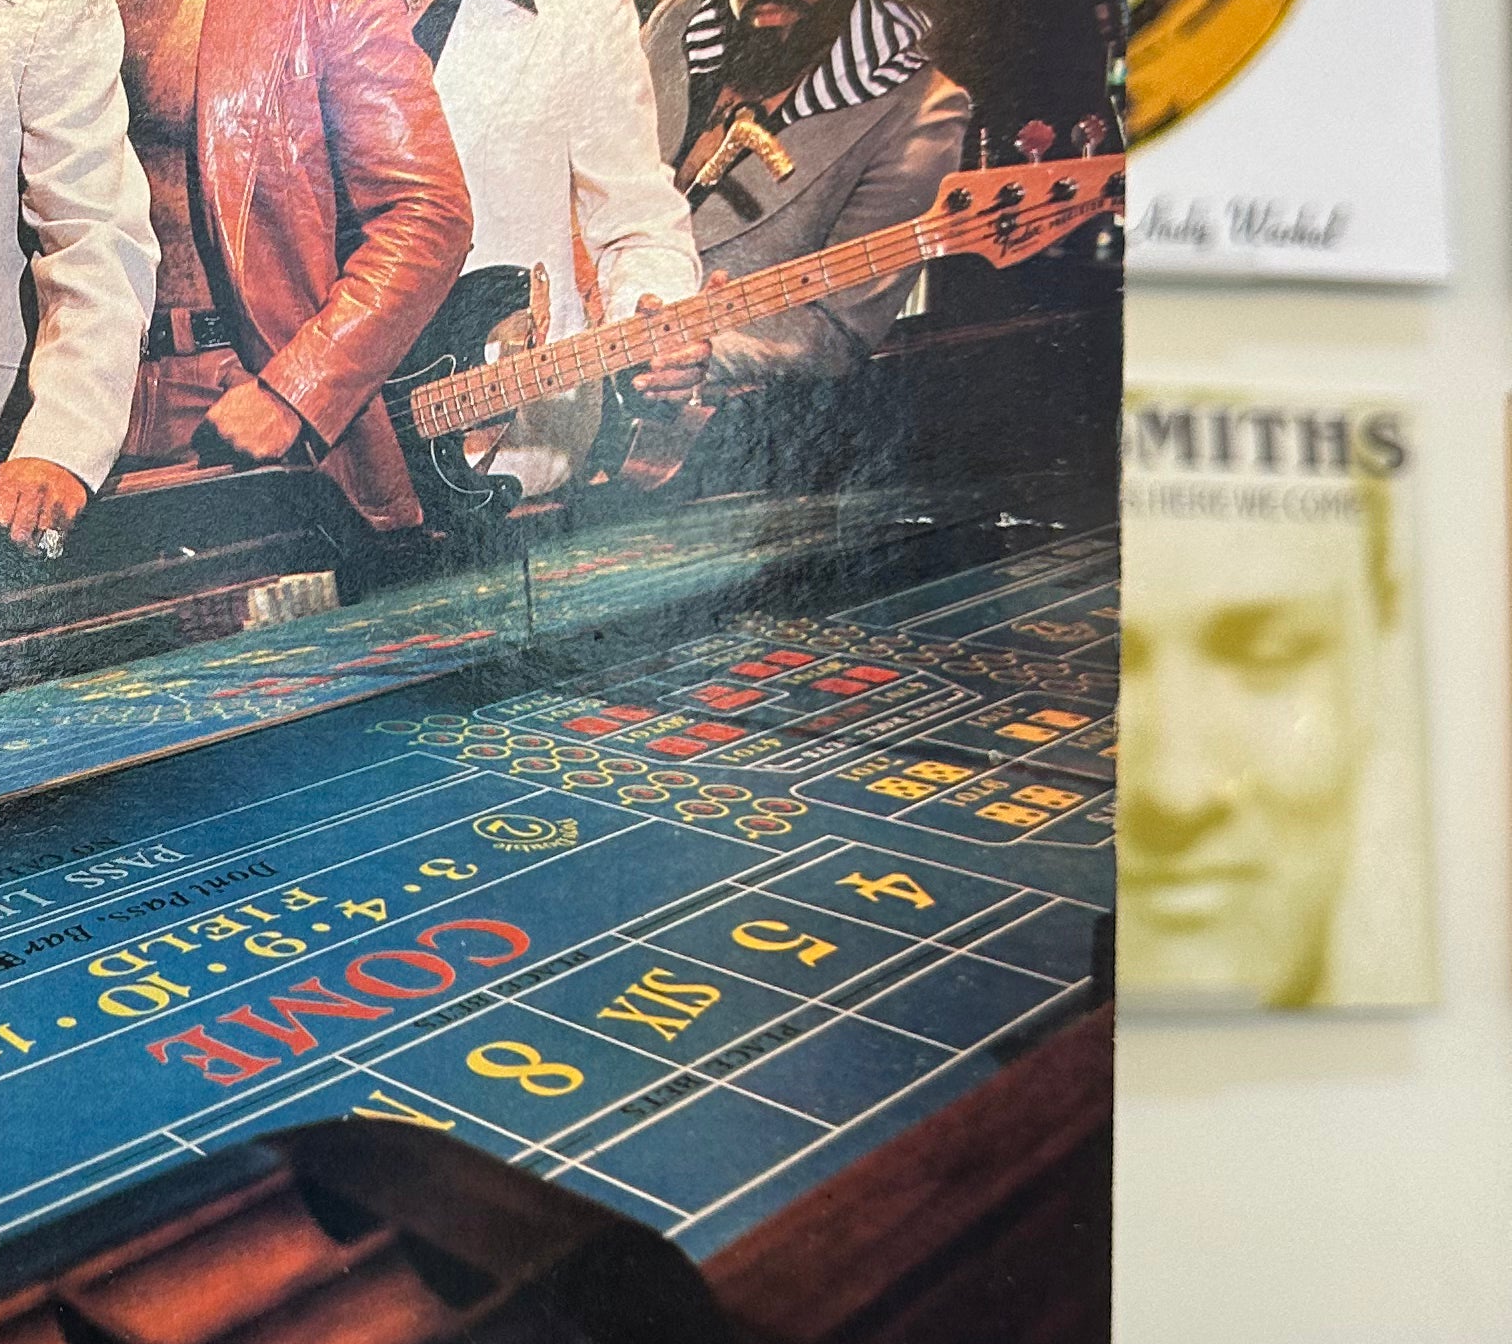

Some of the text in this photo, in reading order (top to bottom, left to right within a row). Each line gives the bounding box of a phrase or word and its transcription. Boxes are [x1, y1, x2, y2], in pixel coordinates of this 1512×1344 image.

[1122, 412, 1406, 480] MITHS
[64, 843, 187, 889] PASS
[419, 857, 479, 882] 3
[835, 871, 937, 910] 4
[23, 924, 94, 956] Bar
[89, 887, 328, 978] FIELD
[244, 930, 308, 958] 9
[731, 919, 839, 967] 5
[96, 974, 192, 1017] 10
[146, 918, 531, 1087] COME
[596, 966, 722, 1043] SIX
[466, 1040, 585, 1097] 8
